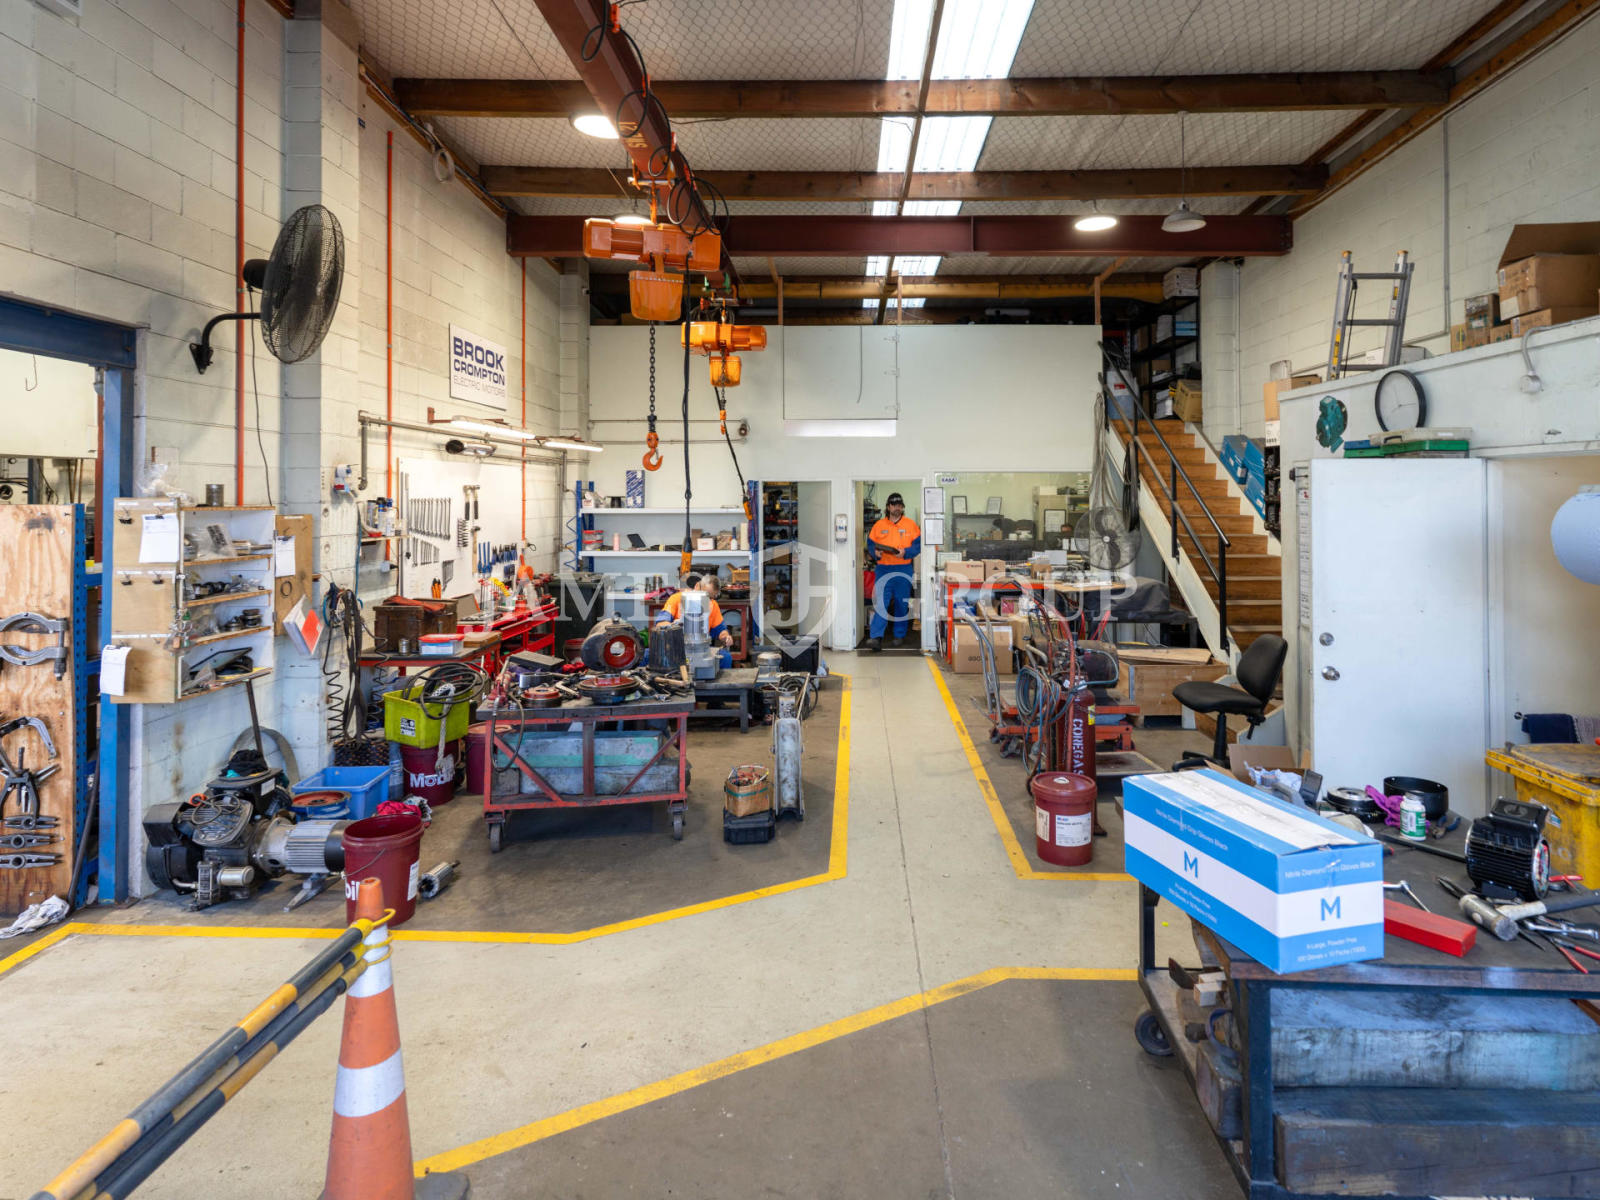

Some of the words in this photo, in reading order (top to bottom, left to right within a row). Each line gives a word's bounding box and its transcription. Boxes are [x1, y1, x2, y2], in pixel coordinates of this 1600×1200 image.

[453, 336, 504, 372] BROOK
[453, 358, 505, 386] CROMPTON
[410, 771, 449, 788] Mob
[1184, 850, 1198, 879] M
[1320, 896, 1341, 921] M
